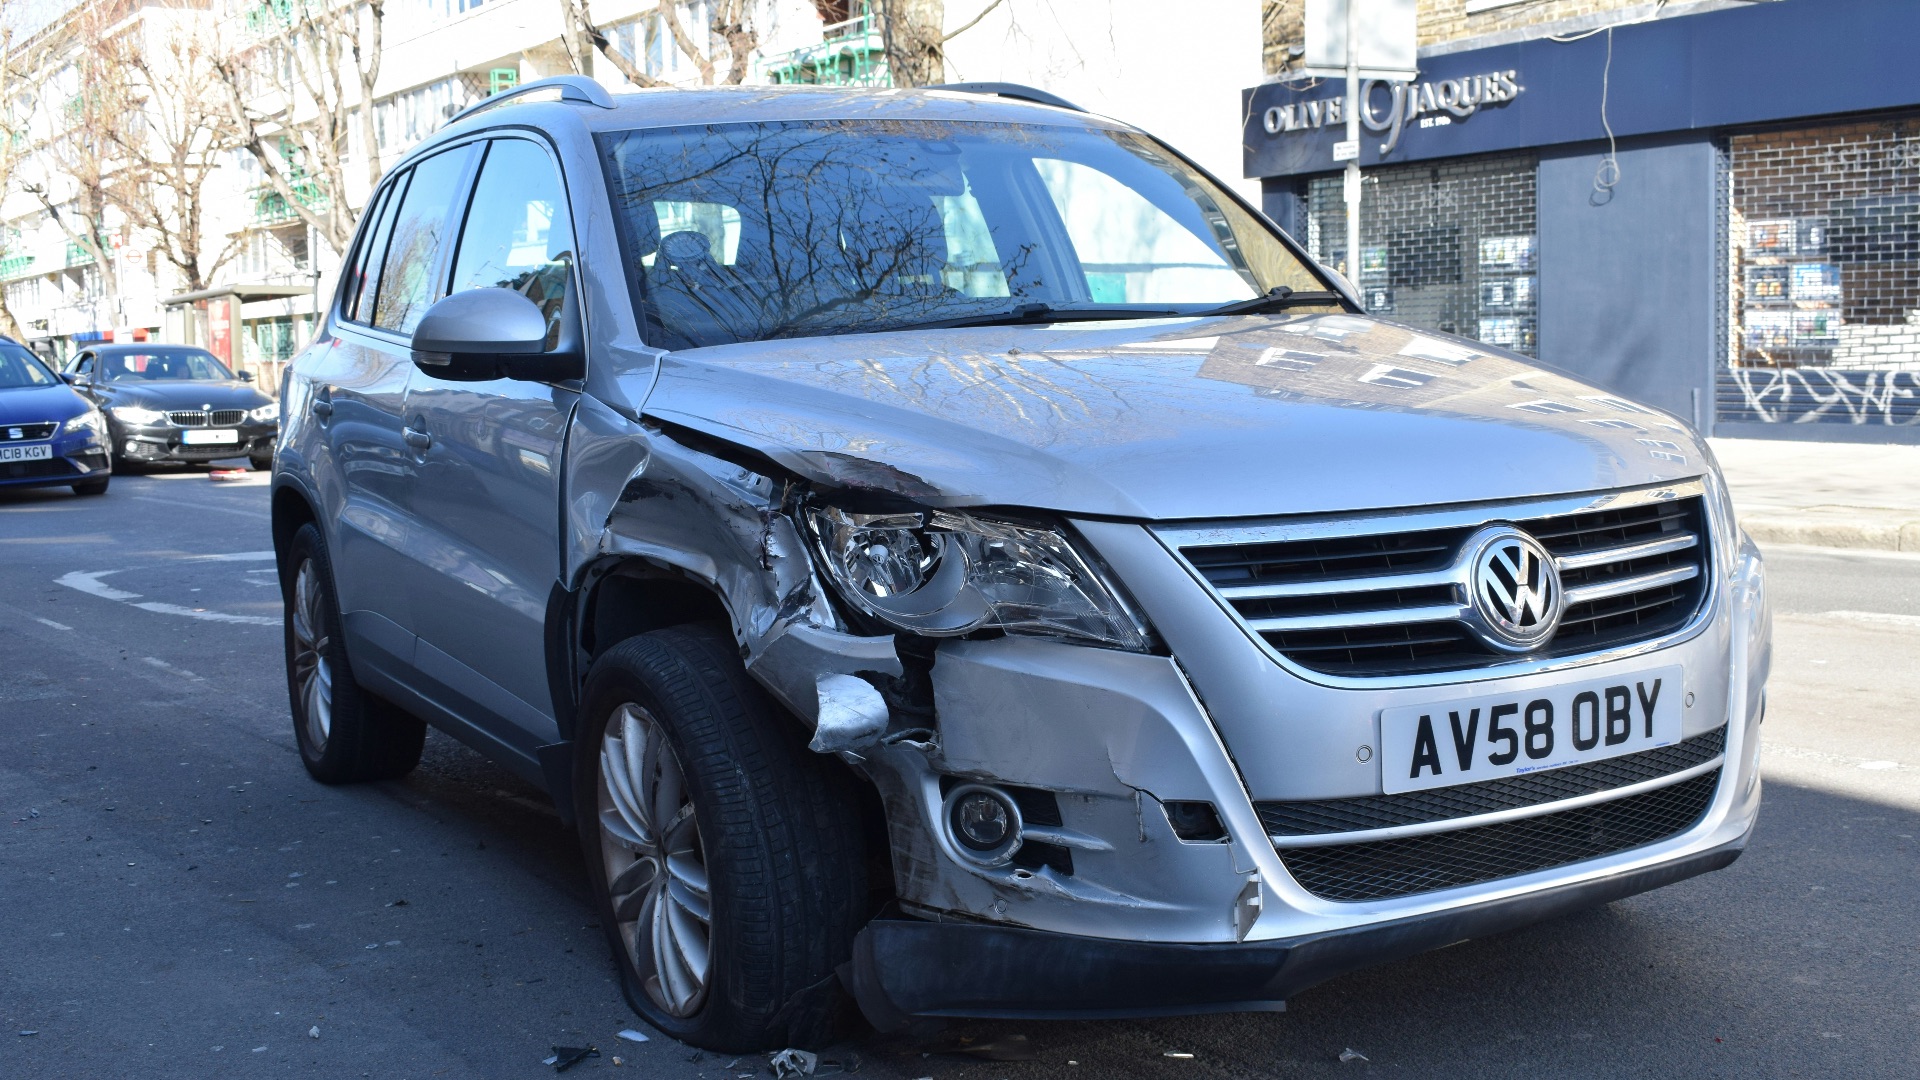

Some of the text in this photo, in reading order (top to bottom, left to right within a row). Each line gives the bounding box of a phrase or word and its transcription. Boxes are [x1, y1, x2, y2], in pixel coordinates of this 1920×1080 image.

[1406, 69, 1517, 122] JAQUES
[24, 446, 47, 458] KGV
[1409, 698, 1554, 779] AV58
